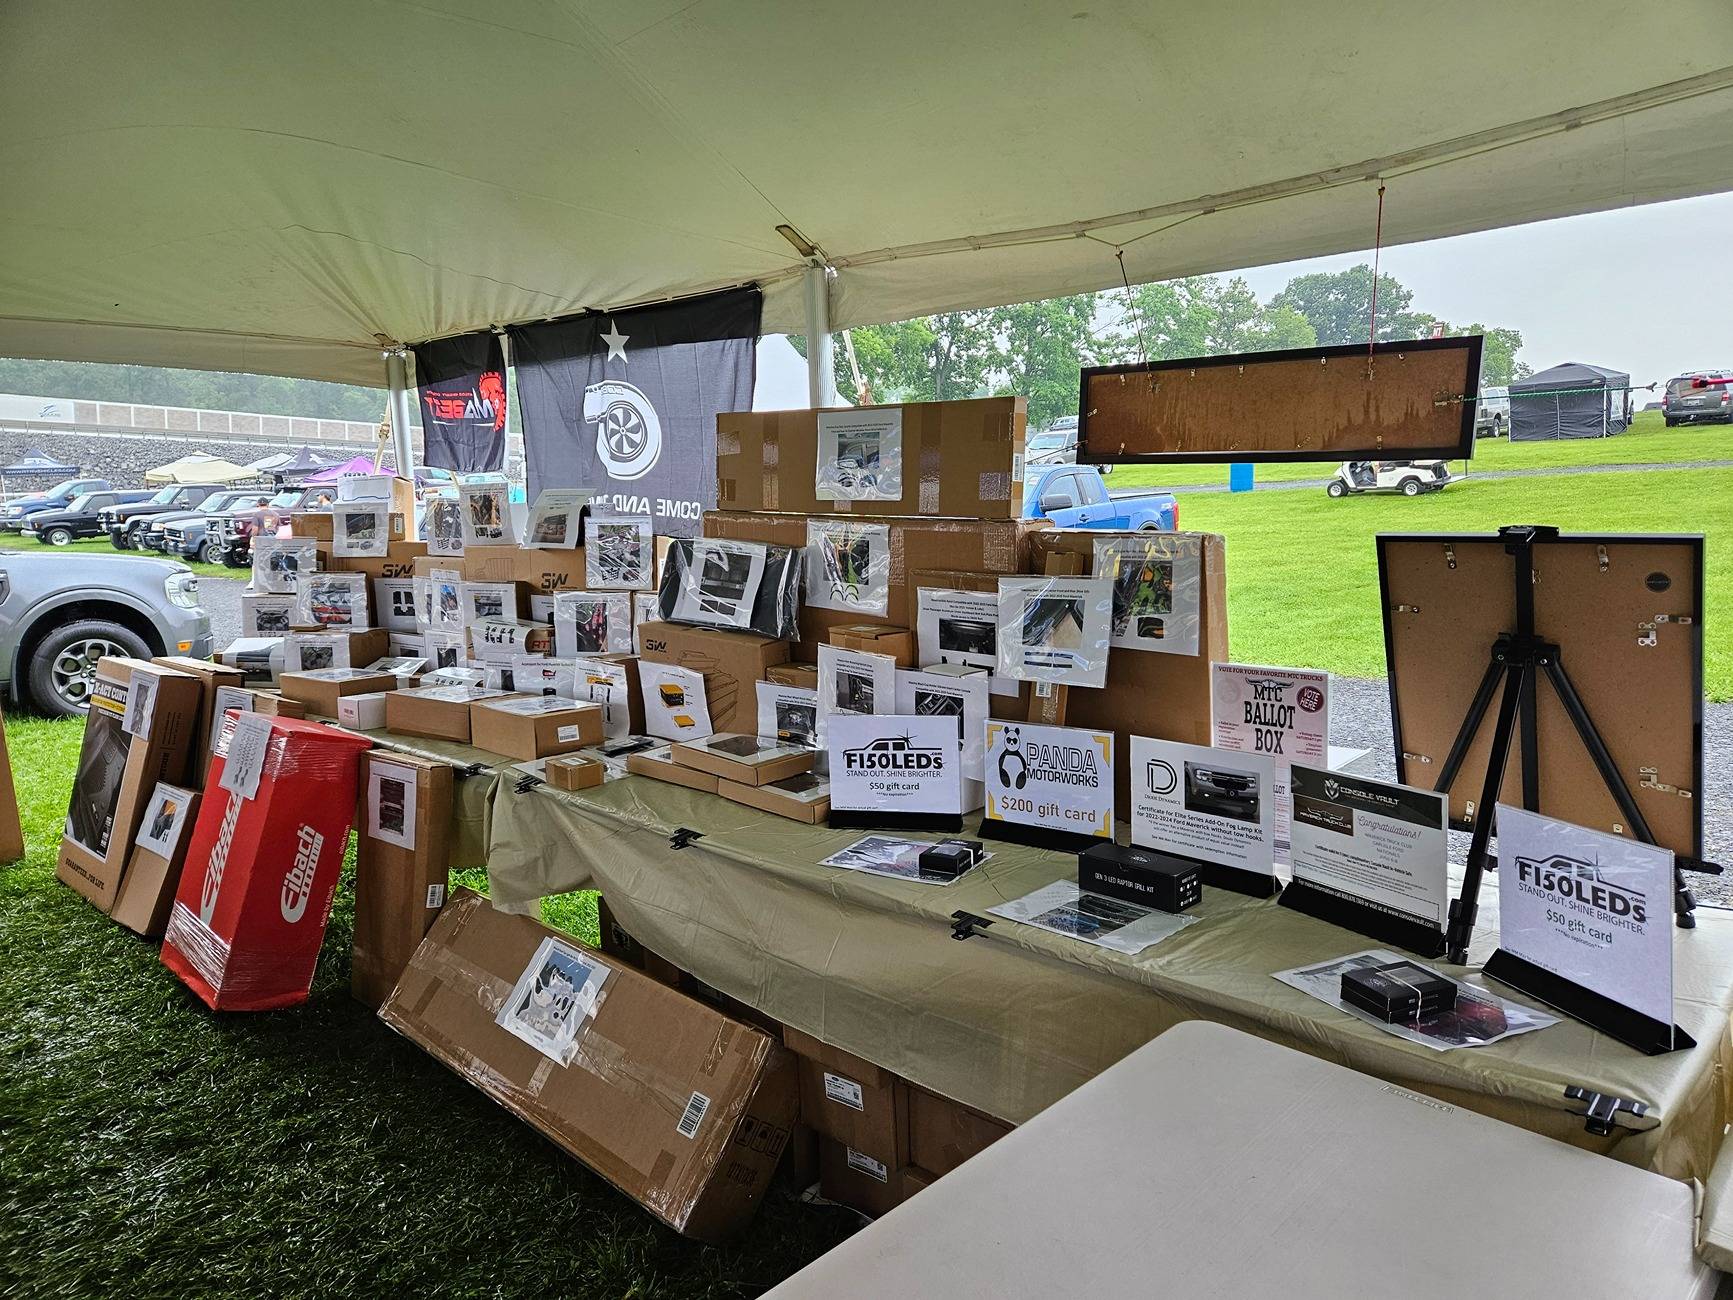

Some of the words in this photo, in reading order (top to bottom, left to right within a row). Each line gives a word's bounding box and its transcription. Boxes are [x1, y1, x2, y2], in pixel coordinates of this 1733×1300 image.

[1260, 669, 1287, 678] FAVORITE
[1253, 685, 1283, 702] MTC
[1300, 697, 1318, 711] HERE
[1303, 688, 1320, 701] VOTE
[1243, 700, 1296, 730] BALLOT
[1254, 727, 1284, 754] BOX
[1026, 742, 1098, 775] PANDA
[846, 769, 869, 777] STAND
[869, 769, 886, 778] OUT.
[886, 770, 906, 778] SHINE
[907, 770, 943, 778] BRIGHTER.
[869, 781, 885, 790] $50
[886, 782, 900, 791] gift
[901, 782, 920, 790] card
[1026, 767, 1099, 788] MOTORWORKS
[1001, 795, 1033, 813] $200
[1038, 802, 1060, 817] gift
[1064, 809, 1096, 823] card
[1340, 786, 1375, 800] CONSOLE
[1375, 794, 1400, 805] VAULT
[1138, 804, 1165, 814] Certificate
[1187, 814, 1204, 823] Series
[1204, 818, 1225, 827] Add-On
[1226, 822, 1236, 830] Fog
[1237, 824, 1253, 834] Lamp
[1145, 812, 1172, 823] 2022-2024
[1186, 821, 1209, 831] Maverick
[1210, 826, 1232, 835] without
[1245, 833, 1264, 842] hooks.
[1357, 814, 1422, 842] Congratulations!
[281, 825, 317, 924] Eibach
[1108, 876, 1117, 884] LED
[1116, 878, 1134, 888] RAPTOR
[1518, 882, 1546, 900] STAND
[1546, 891, 1568, 909] OUT.
[1568, 901, 1595, 919] SHINE
[1596, 910, 1646, 936] BRIGHTER.
[1546, 908, 1566, 927] $50
[1567, 917, 1586, 935] gift
[1588, 926, 1612, 944] card
